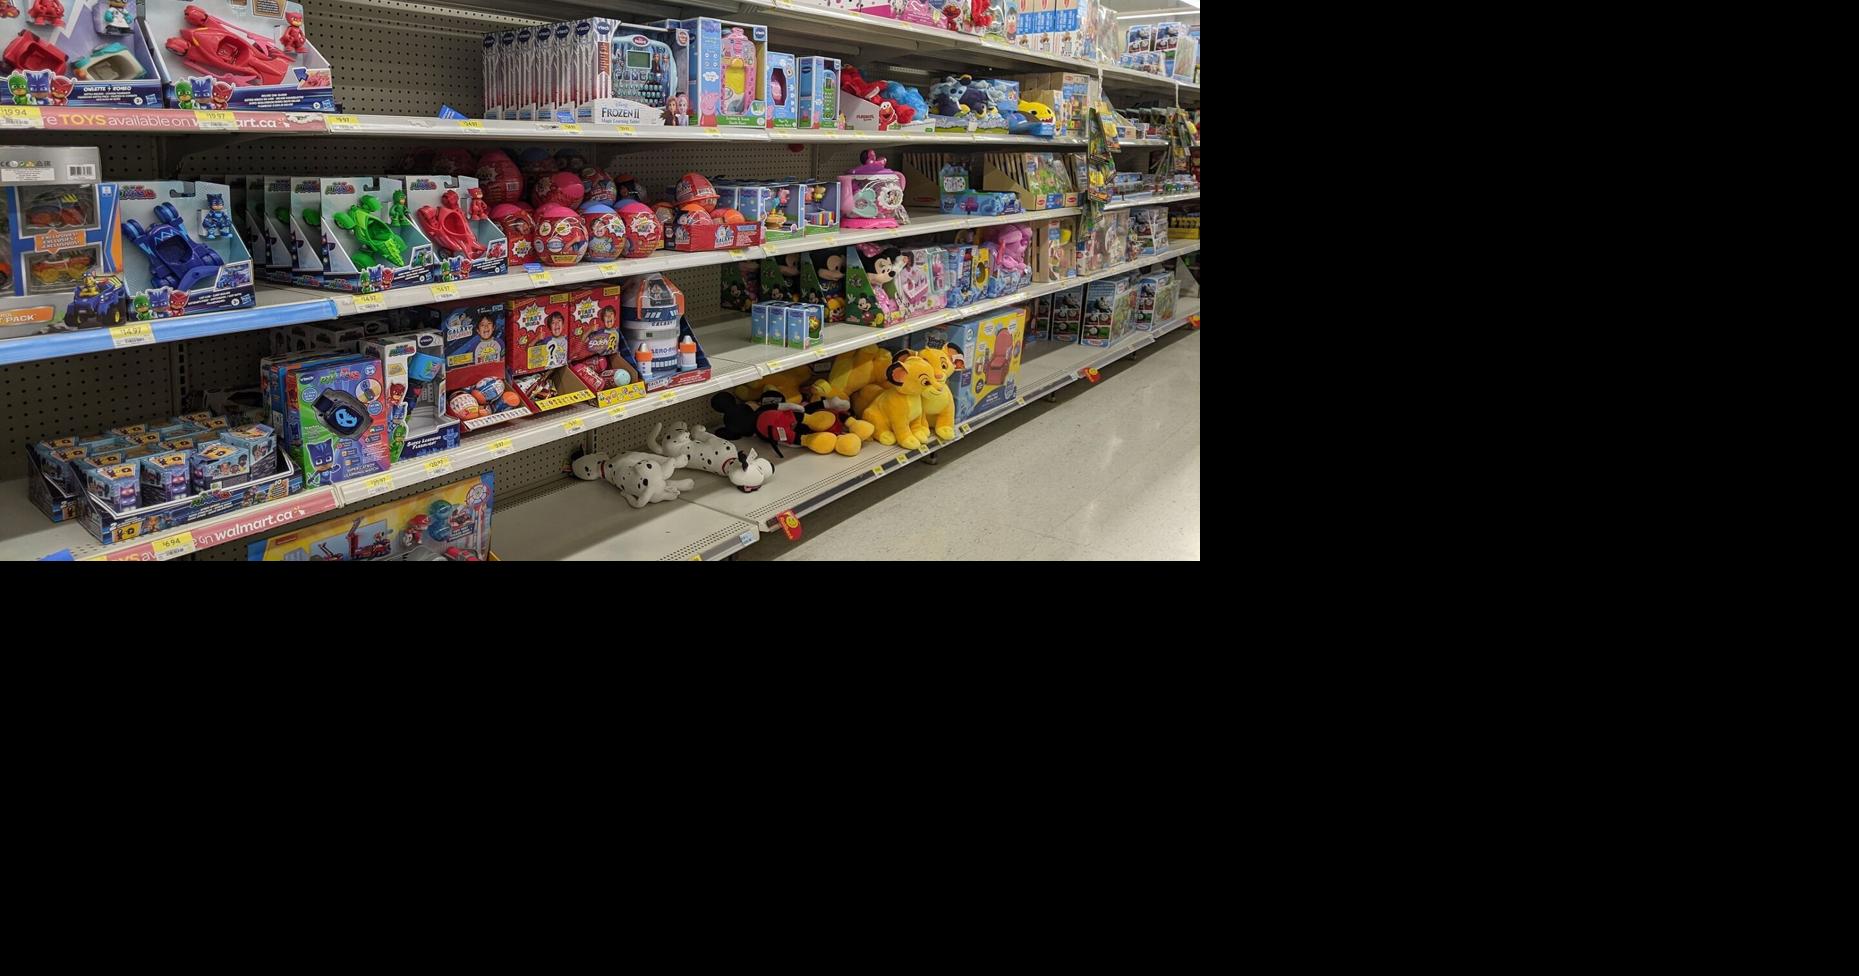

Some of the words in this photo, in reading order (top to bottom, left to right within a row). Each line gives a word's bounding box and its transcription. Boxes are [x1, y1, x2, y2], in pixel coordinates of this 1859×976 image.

[601, 108, 633, 118] FROZEN
[634, 109, 640, 119] II
[59, 114, 106, 125] TOYS
[109, 114, 168, 127] available
[170, 117, 191, 127] on
[6, 315, 34, 323] PACK
[199, 534, 213, 545] on
[214, 510, 293, 538] walmart.ca
